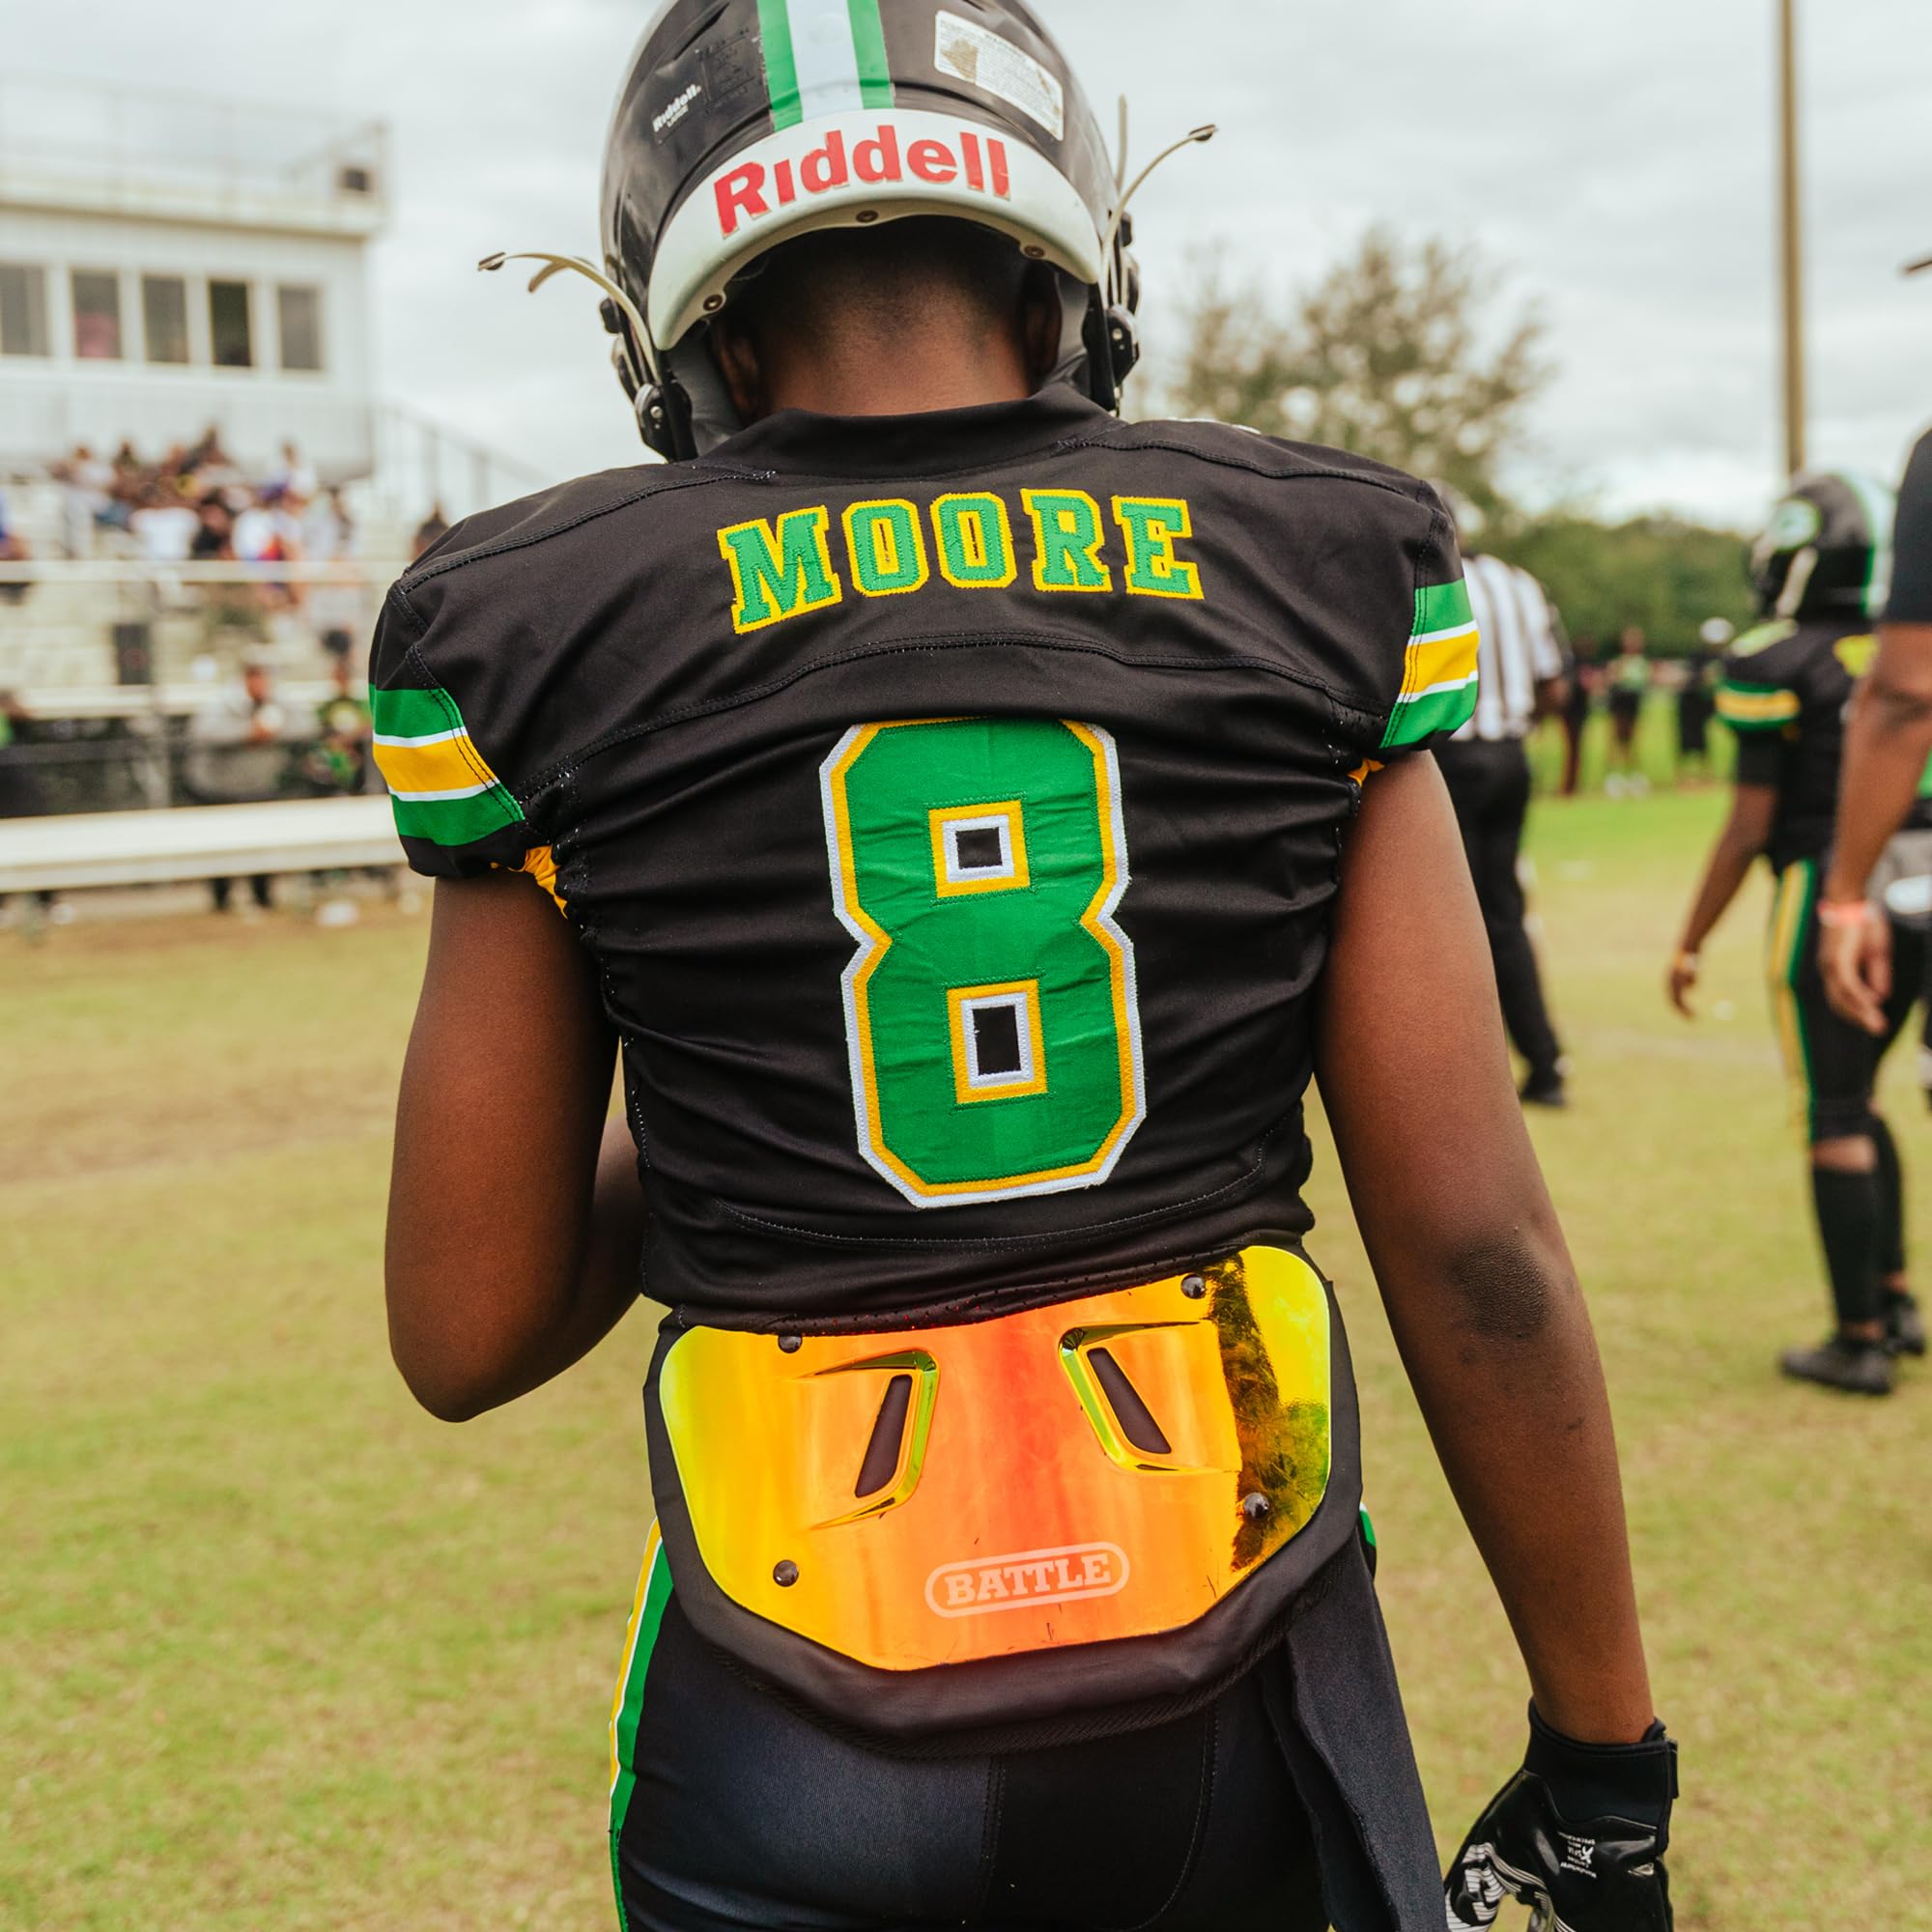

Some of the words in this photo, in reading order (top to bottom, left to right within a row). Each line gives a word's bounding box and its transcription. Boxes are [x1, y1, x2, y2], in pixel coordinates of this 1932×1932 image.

[713, 125, 1011, 240] Riddell
[717, 488, 1205, 635] MOORE
[819, 717, 1147, 1208] 8
[944, 1552, 1111, 1605] BATTLE
